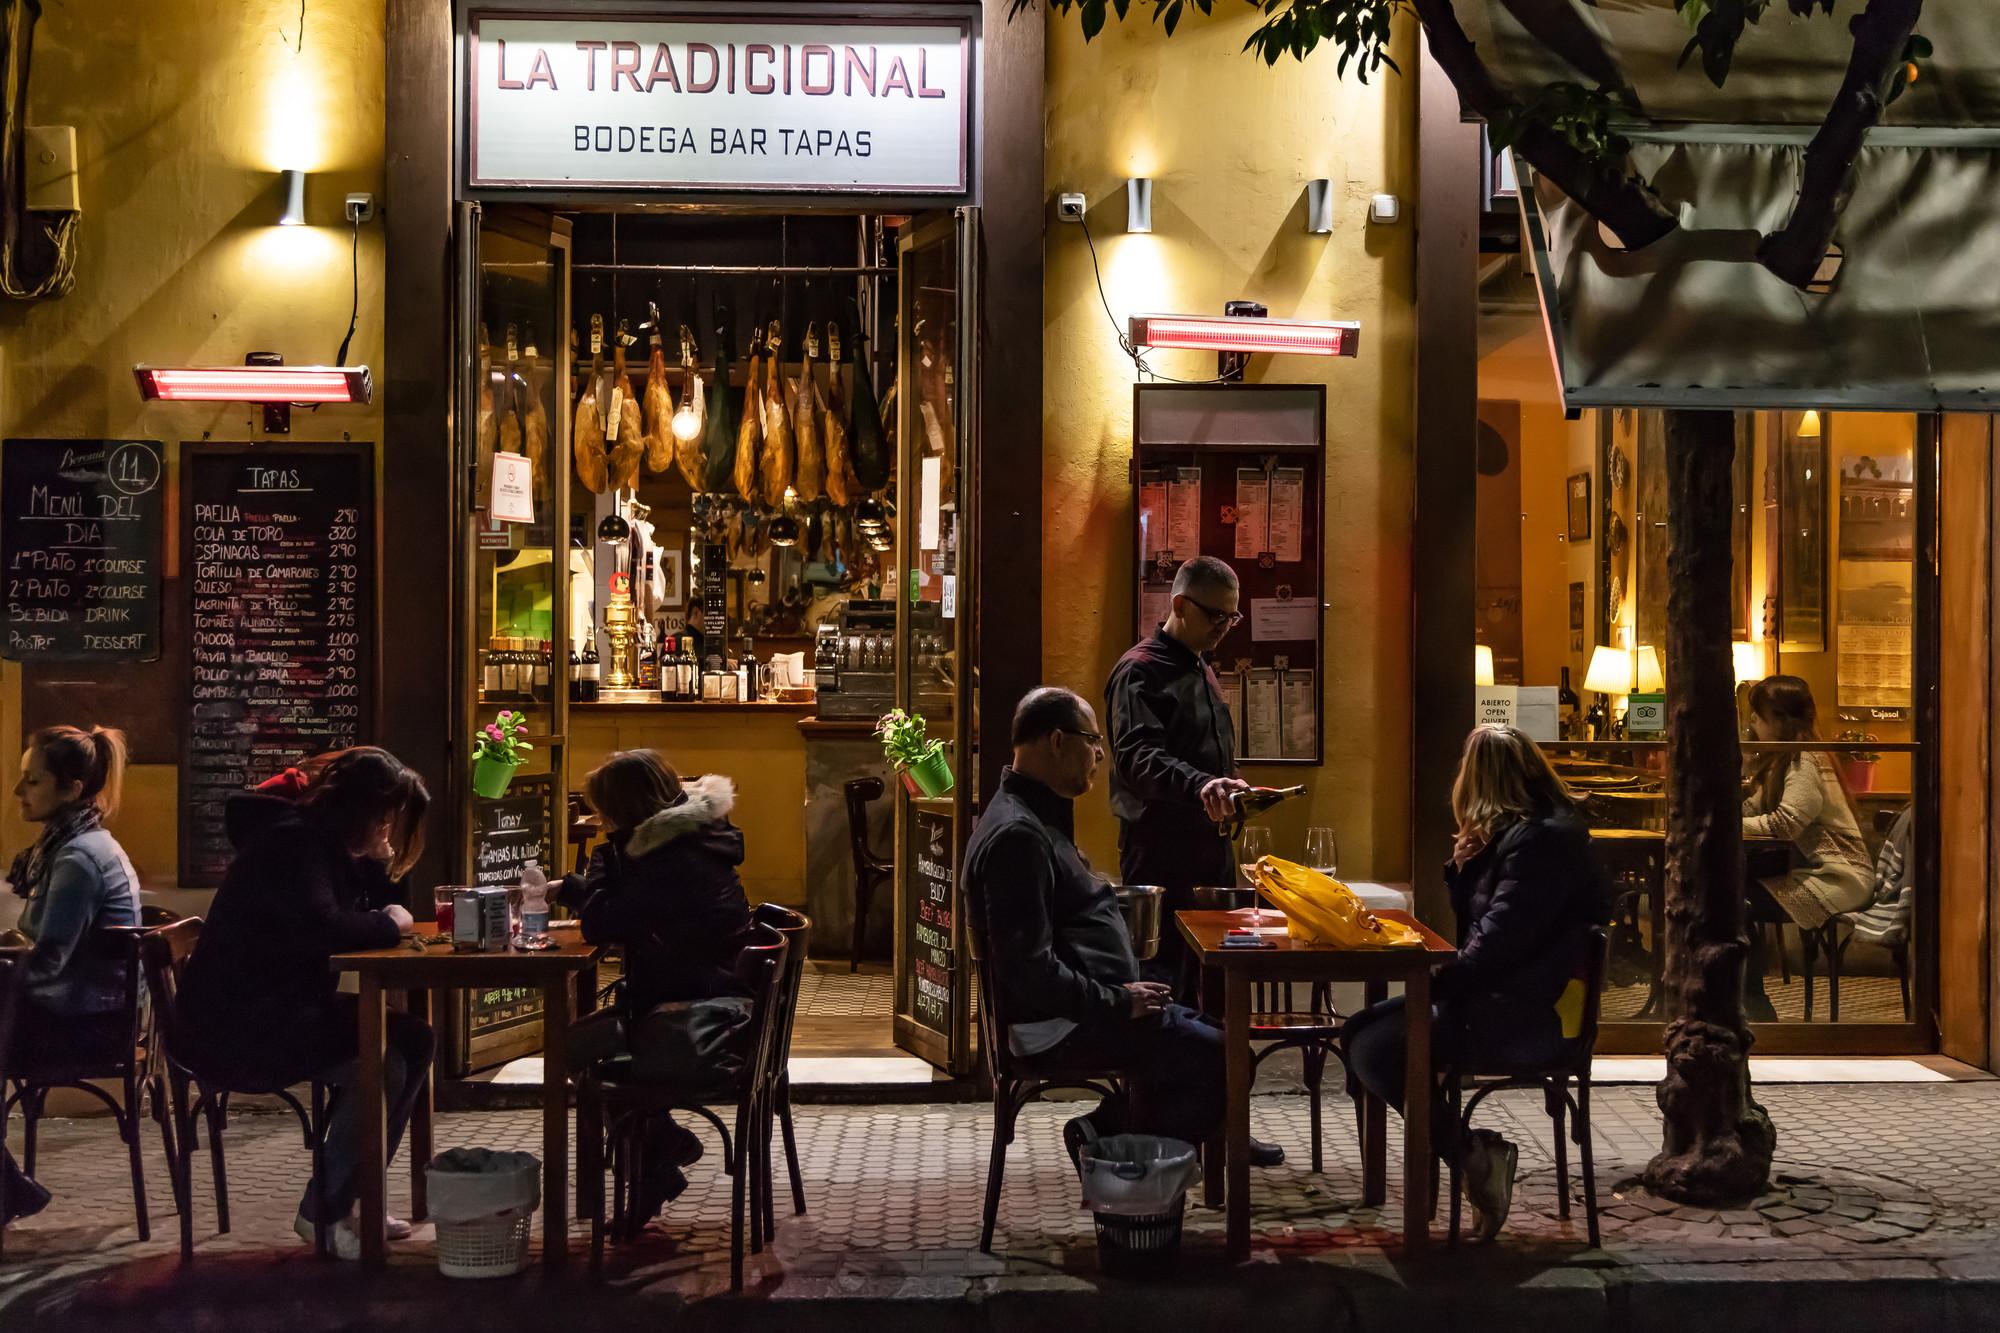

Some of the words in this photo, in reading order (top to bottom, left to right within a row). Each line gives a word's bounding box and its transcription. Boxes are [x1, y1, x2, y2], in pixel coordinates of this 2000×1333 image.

[498, 39, 559, 91] LA
[575, 40, 945, 98] TRADICIONAL
[574, 126, 697, 154] BODEGA
[710, 128, 768, 155] BAR
[779, 129, 873, 157] TAPAS
[246, 467, 300, 489] TAPAS
[97, 494, 142, 518] DEL
[195, 504, 241, 523] PAELLA
[65, 523, 102, 544] DIA
[194, 526, 225, 541] COLA
[232, 529, 247, 542] DE
[248, 526, 284, 541] TORO
[194, 544, 260, 560] ESPINACAS
[193, 562, 242, 579] TORTILLA
[247, 567, 264, 579] DE
[266, 564, 320, 579] CAMARONES
[27, 579, 71, 598] PLATO
[194, 580, 233, 595] QUESO
[8, 603, 70, 622] BEBIDA
[266, 598, 299, 611] POLLO
[84, 607, 130, 623] DRINK
[193, 614, 234, 628] TOMATES
[84, 634, 147, 650] DESSERT
[194, 632, 235, 647] CHOCOS
[1481, 699, 1511, 707] ABIERTO
[1485, 708, 1506, 716] OPEN
[1871, 709, 1899, 720] Cajasol
